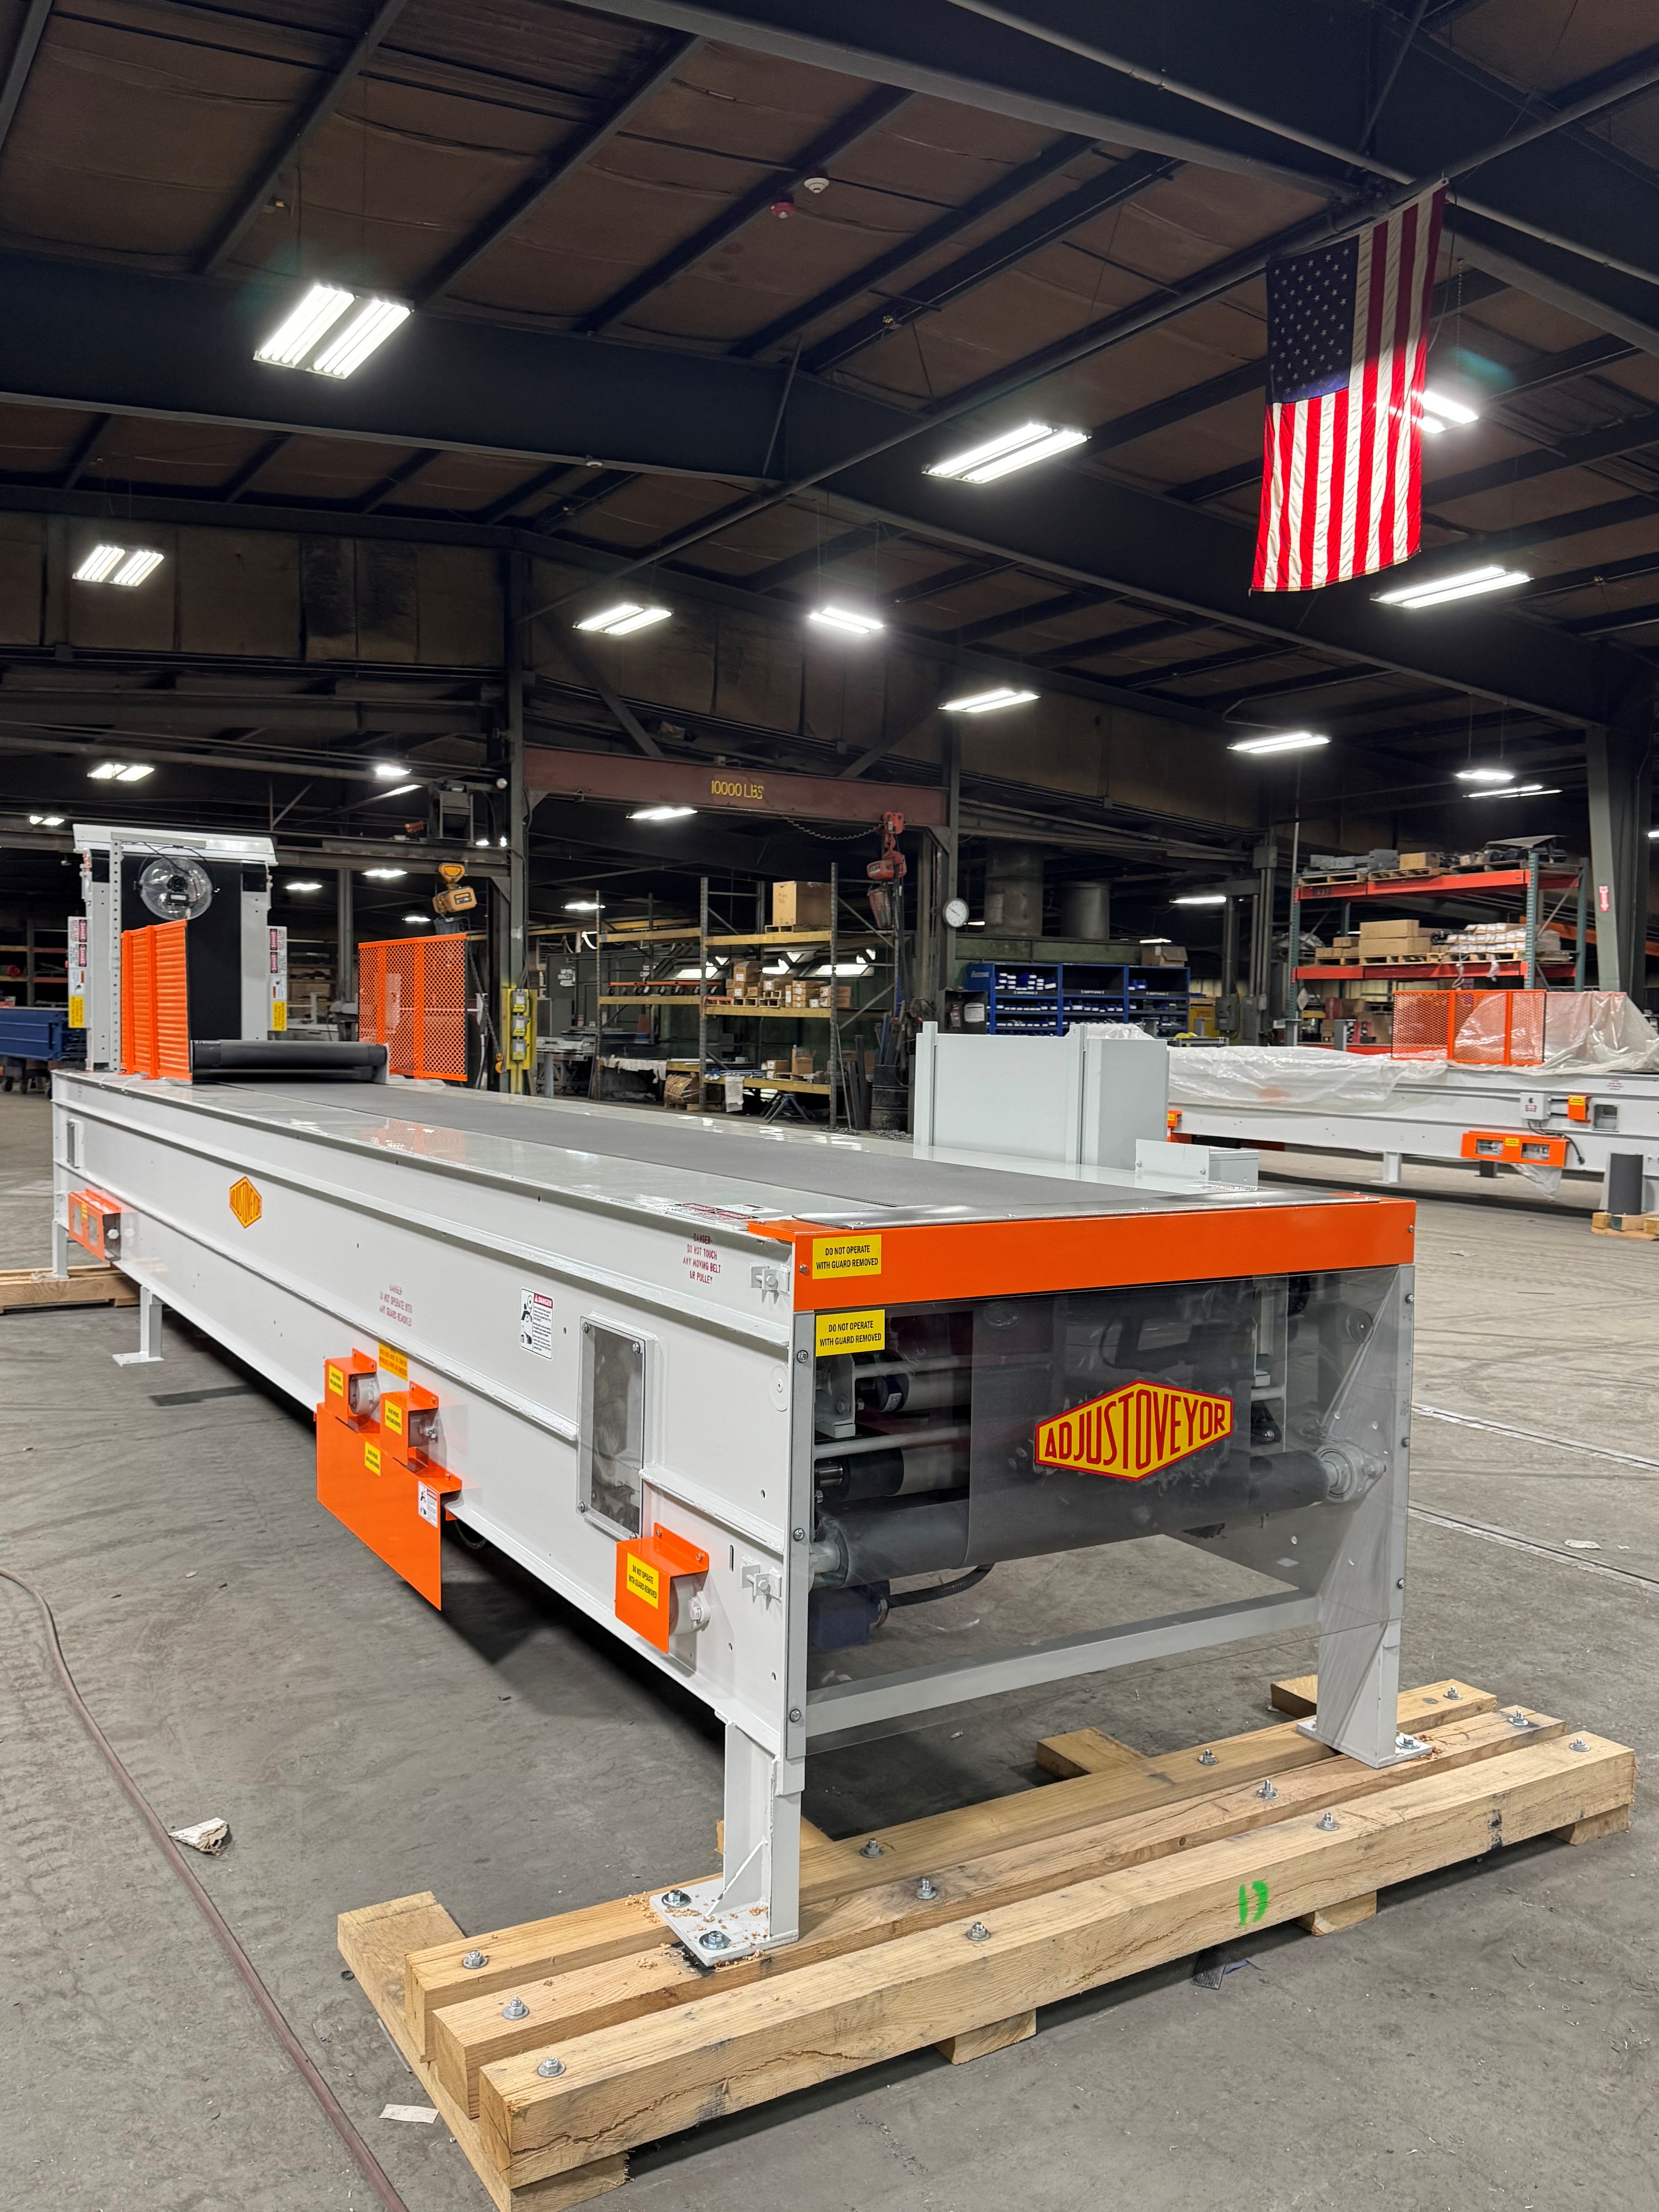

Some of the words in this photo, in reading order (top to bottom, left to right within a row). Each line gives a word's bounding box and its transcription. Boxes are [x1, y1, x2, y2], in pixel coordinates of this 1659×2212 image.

[711, 780, 742, 797] 10000
[744, 784, 764, 799] LBS
[694, 1246, 702, 1255] NOT
[703, 1248, 717, 1260] TOUCH
[825, 1248, 833, 1256] DO
[835, 1247, 845, 1255] NOT
[846, 1245, 870, 1254] OPERATE
[683, 1257, 691, 1266] ANY
[693, 1259, 709, 1271] MOVING
[710, 1262, 721, 1274] BELT
[816, 1261, 830, 1270] WITH
[831, 1260, 851, 1268] GUARD
[852, 1258, 878, 1267] REMOVED
[697, 1272, 713, 1284] PULLEY
[829, 1324, 836, 1332] DO
[838, 1323, 848, 1331] NOT
[850, 1321, 873, 1330] OPERATE
[820, 1338, 833, 1347] WITH
[835, 1336, 854, 1345] GUARD
[855, 1333, 881, 1343] REMOVED
[1044, 1389, 1226, 1470] ADJUSTOVEYOR
